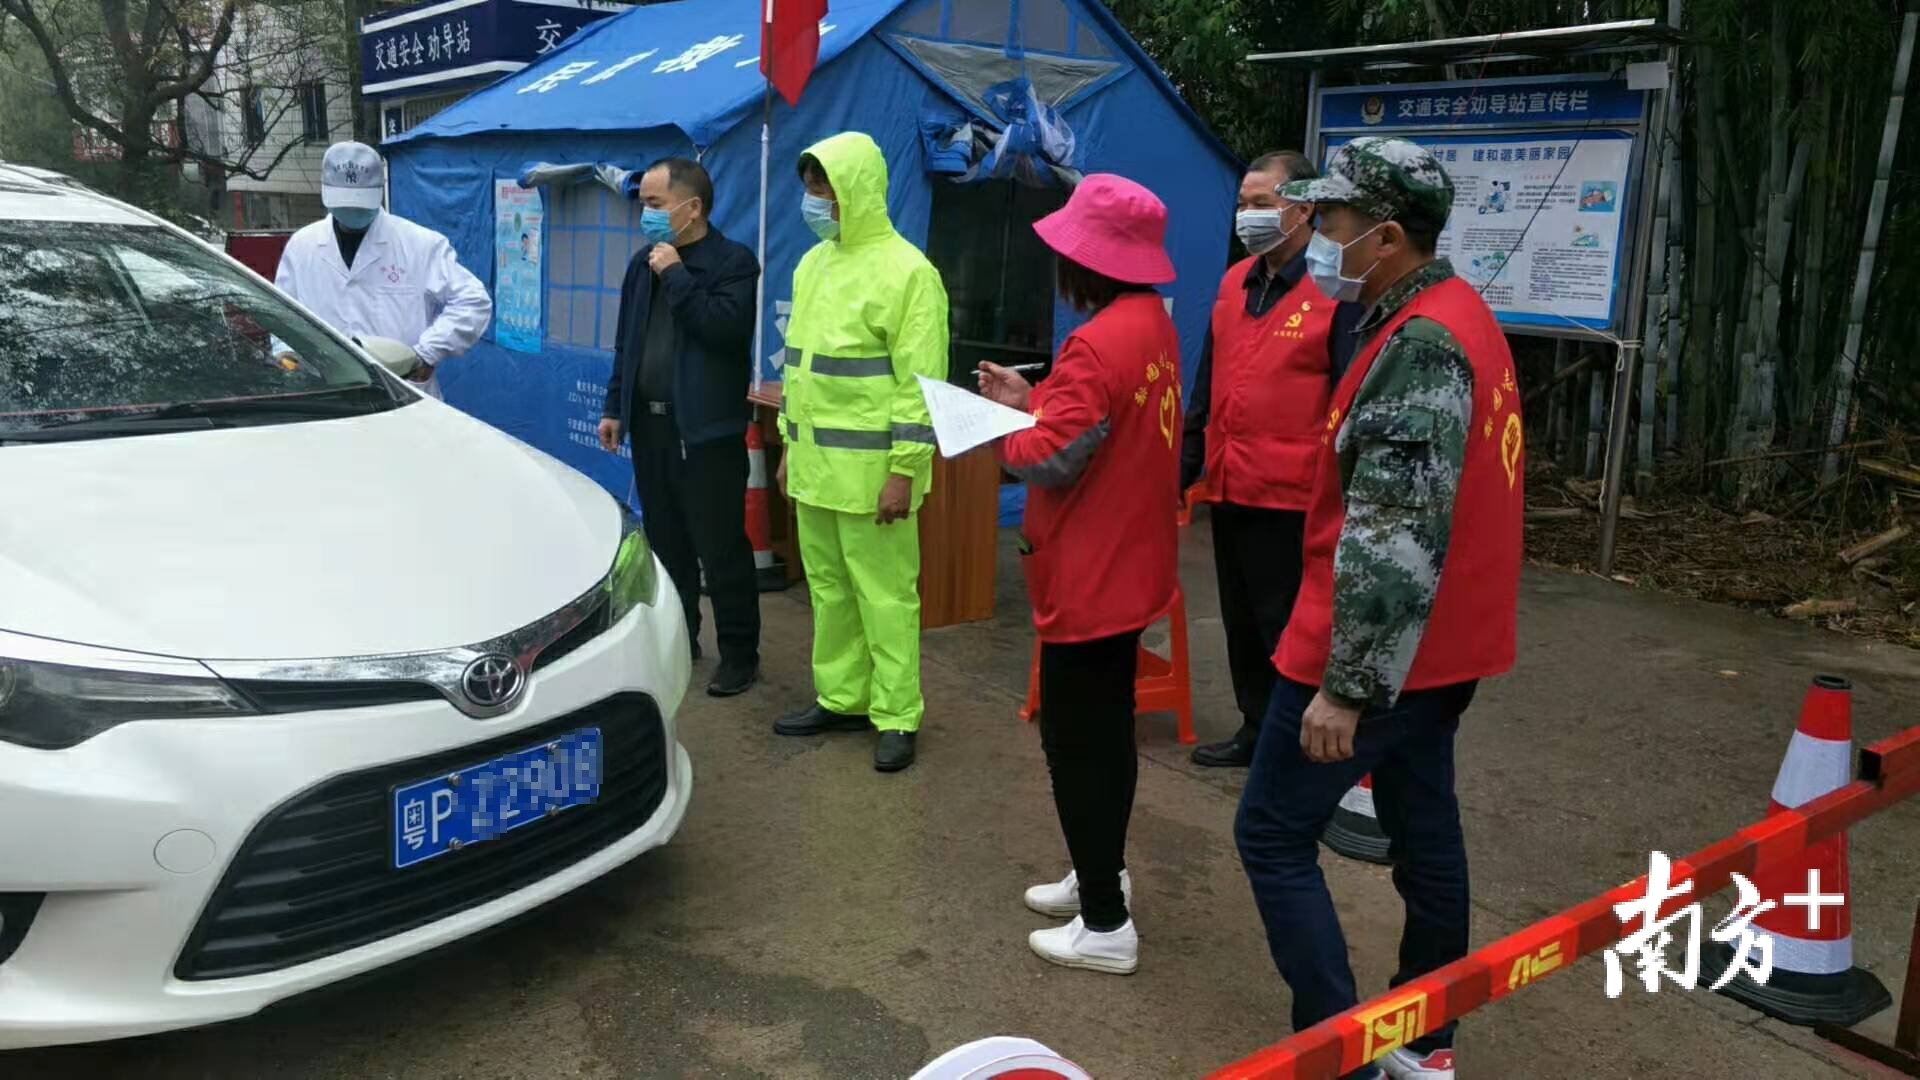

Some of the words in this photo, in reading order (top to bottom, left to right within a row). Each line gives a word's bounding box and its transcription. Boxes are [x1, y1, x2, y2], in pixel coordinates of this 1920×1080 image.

[375, 20, 471, 71] 交通安全劝导站
[1398, 90, 1589, 118] 交通安全劝导站宣传栏
